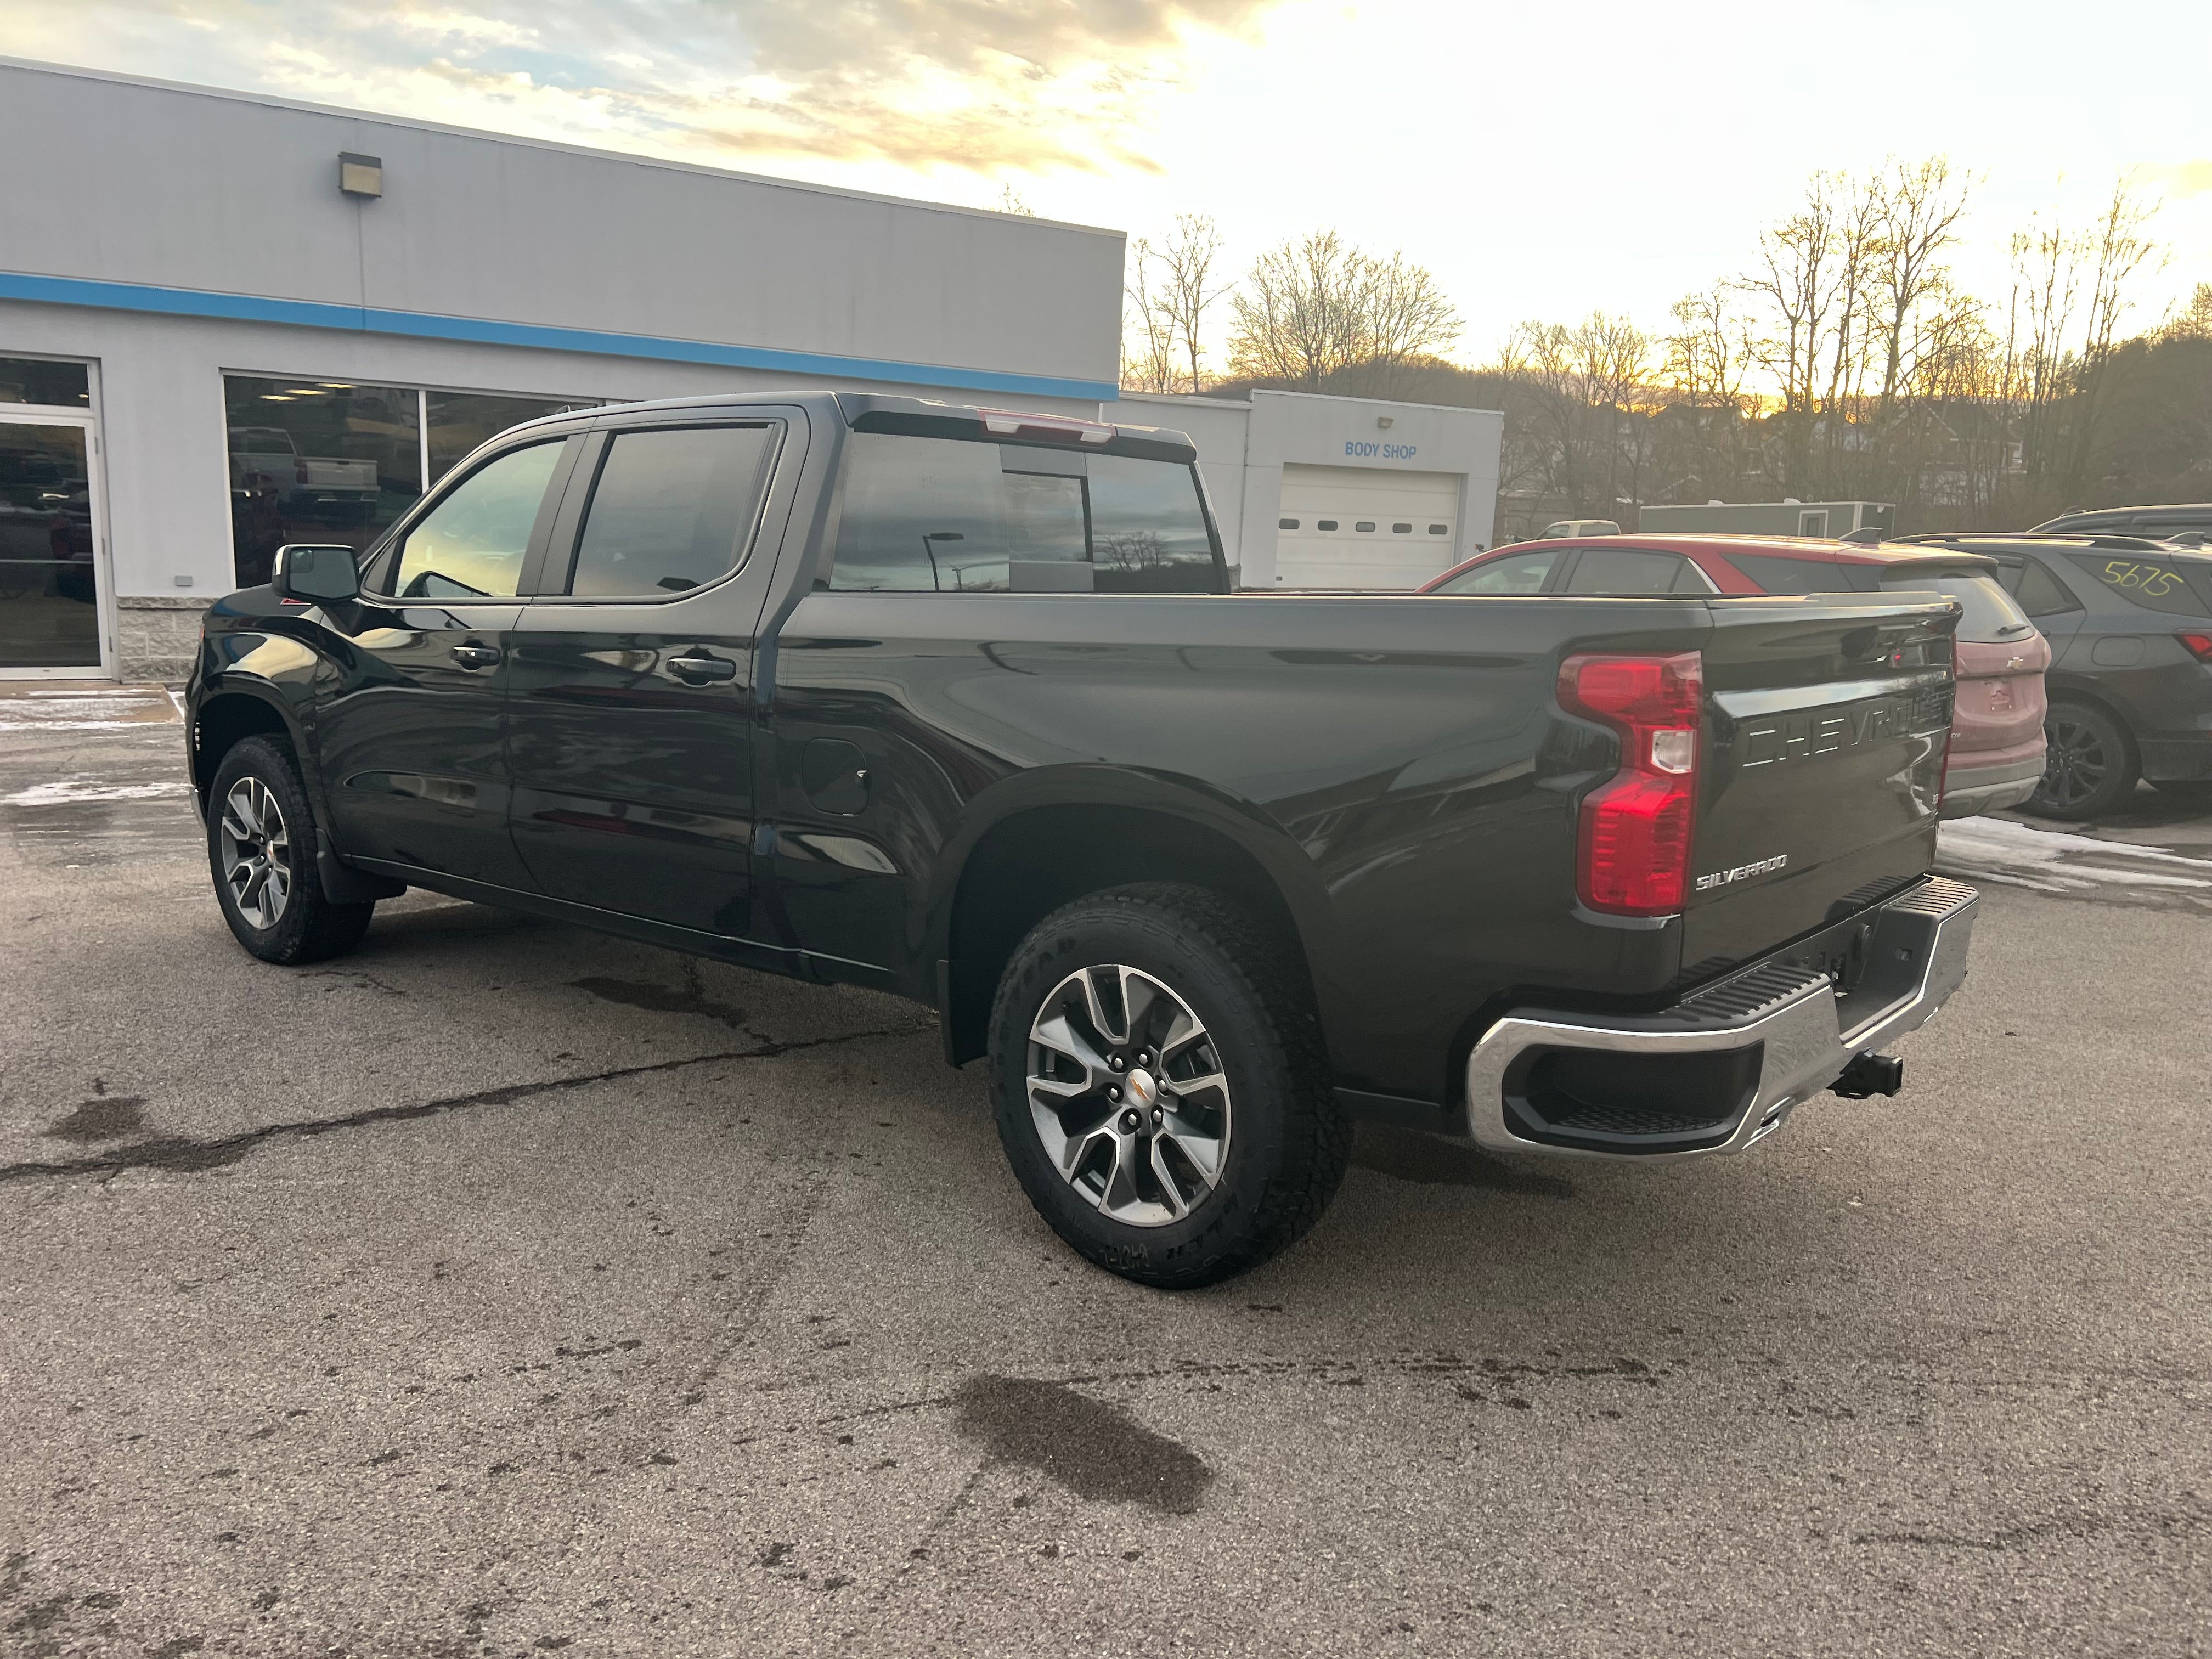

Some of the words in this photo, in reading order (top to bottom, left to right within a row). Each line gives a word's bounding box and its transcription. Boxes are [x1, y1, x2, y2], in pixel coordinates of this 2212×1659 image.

[1345, 441, 1379, 457] BODY
[1383, 444, 1417, 459] SHOP
[2100, 561, 2185, 596] 5675
[1696, 854, 1788, 891] SILVERADO
